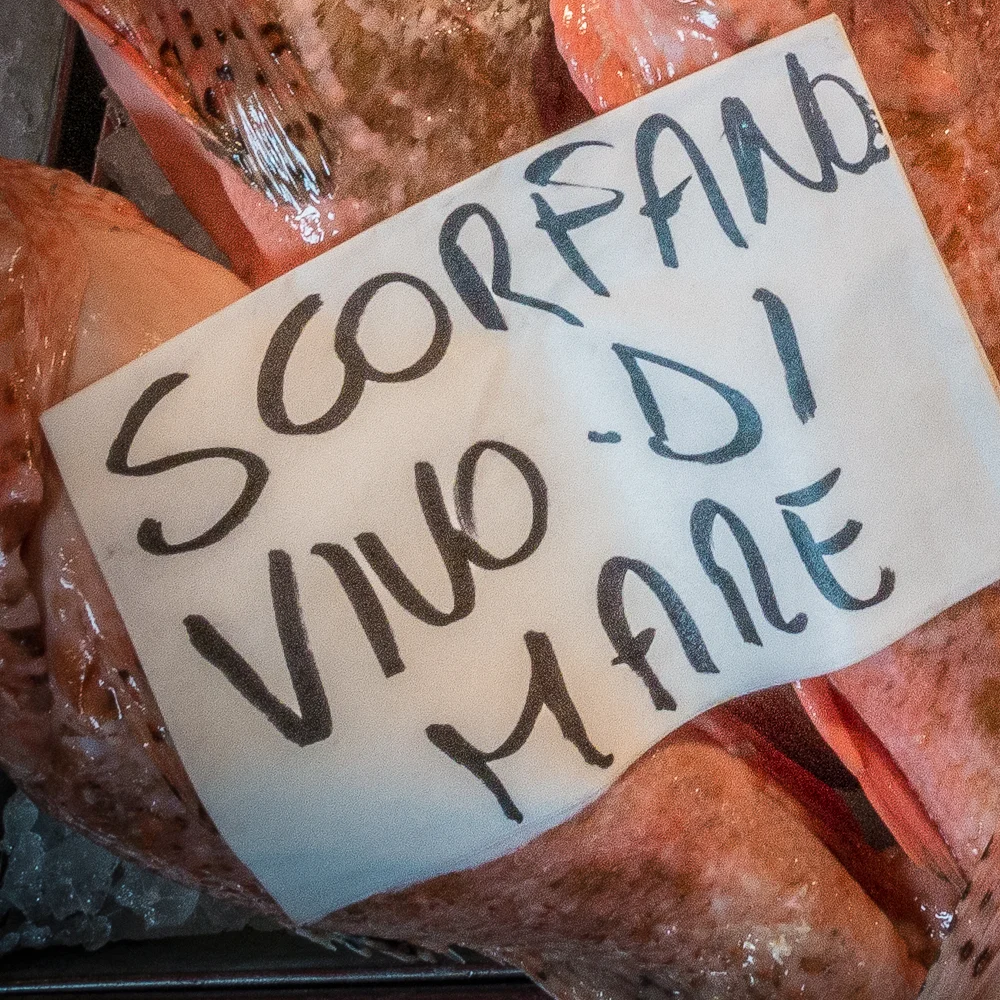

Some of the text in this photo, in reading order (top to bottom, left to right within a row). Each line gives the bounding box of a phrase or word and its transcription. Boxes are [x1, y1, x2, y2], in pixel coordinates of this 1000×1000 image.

[106, 53, 890, 556] SCORFANO
[183, 439, 549, 748] VIVO
[426, 468, 896, 824] MARE
